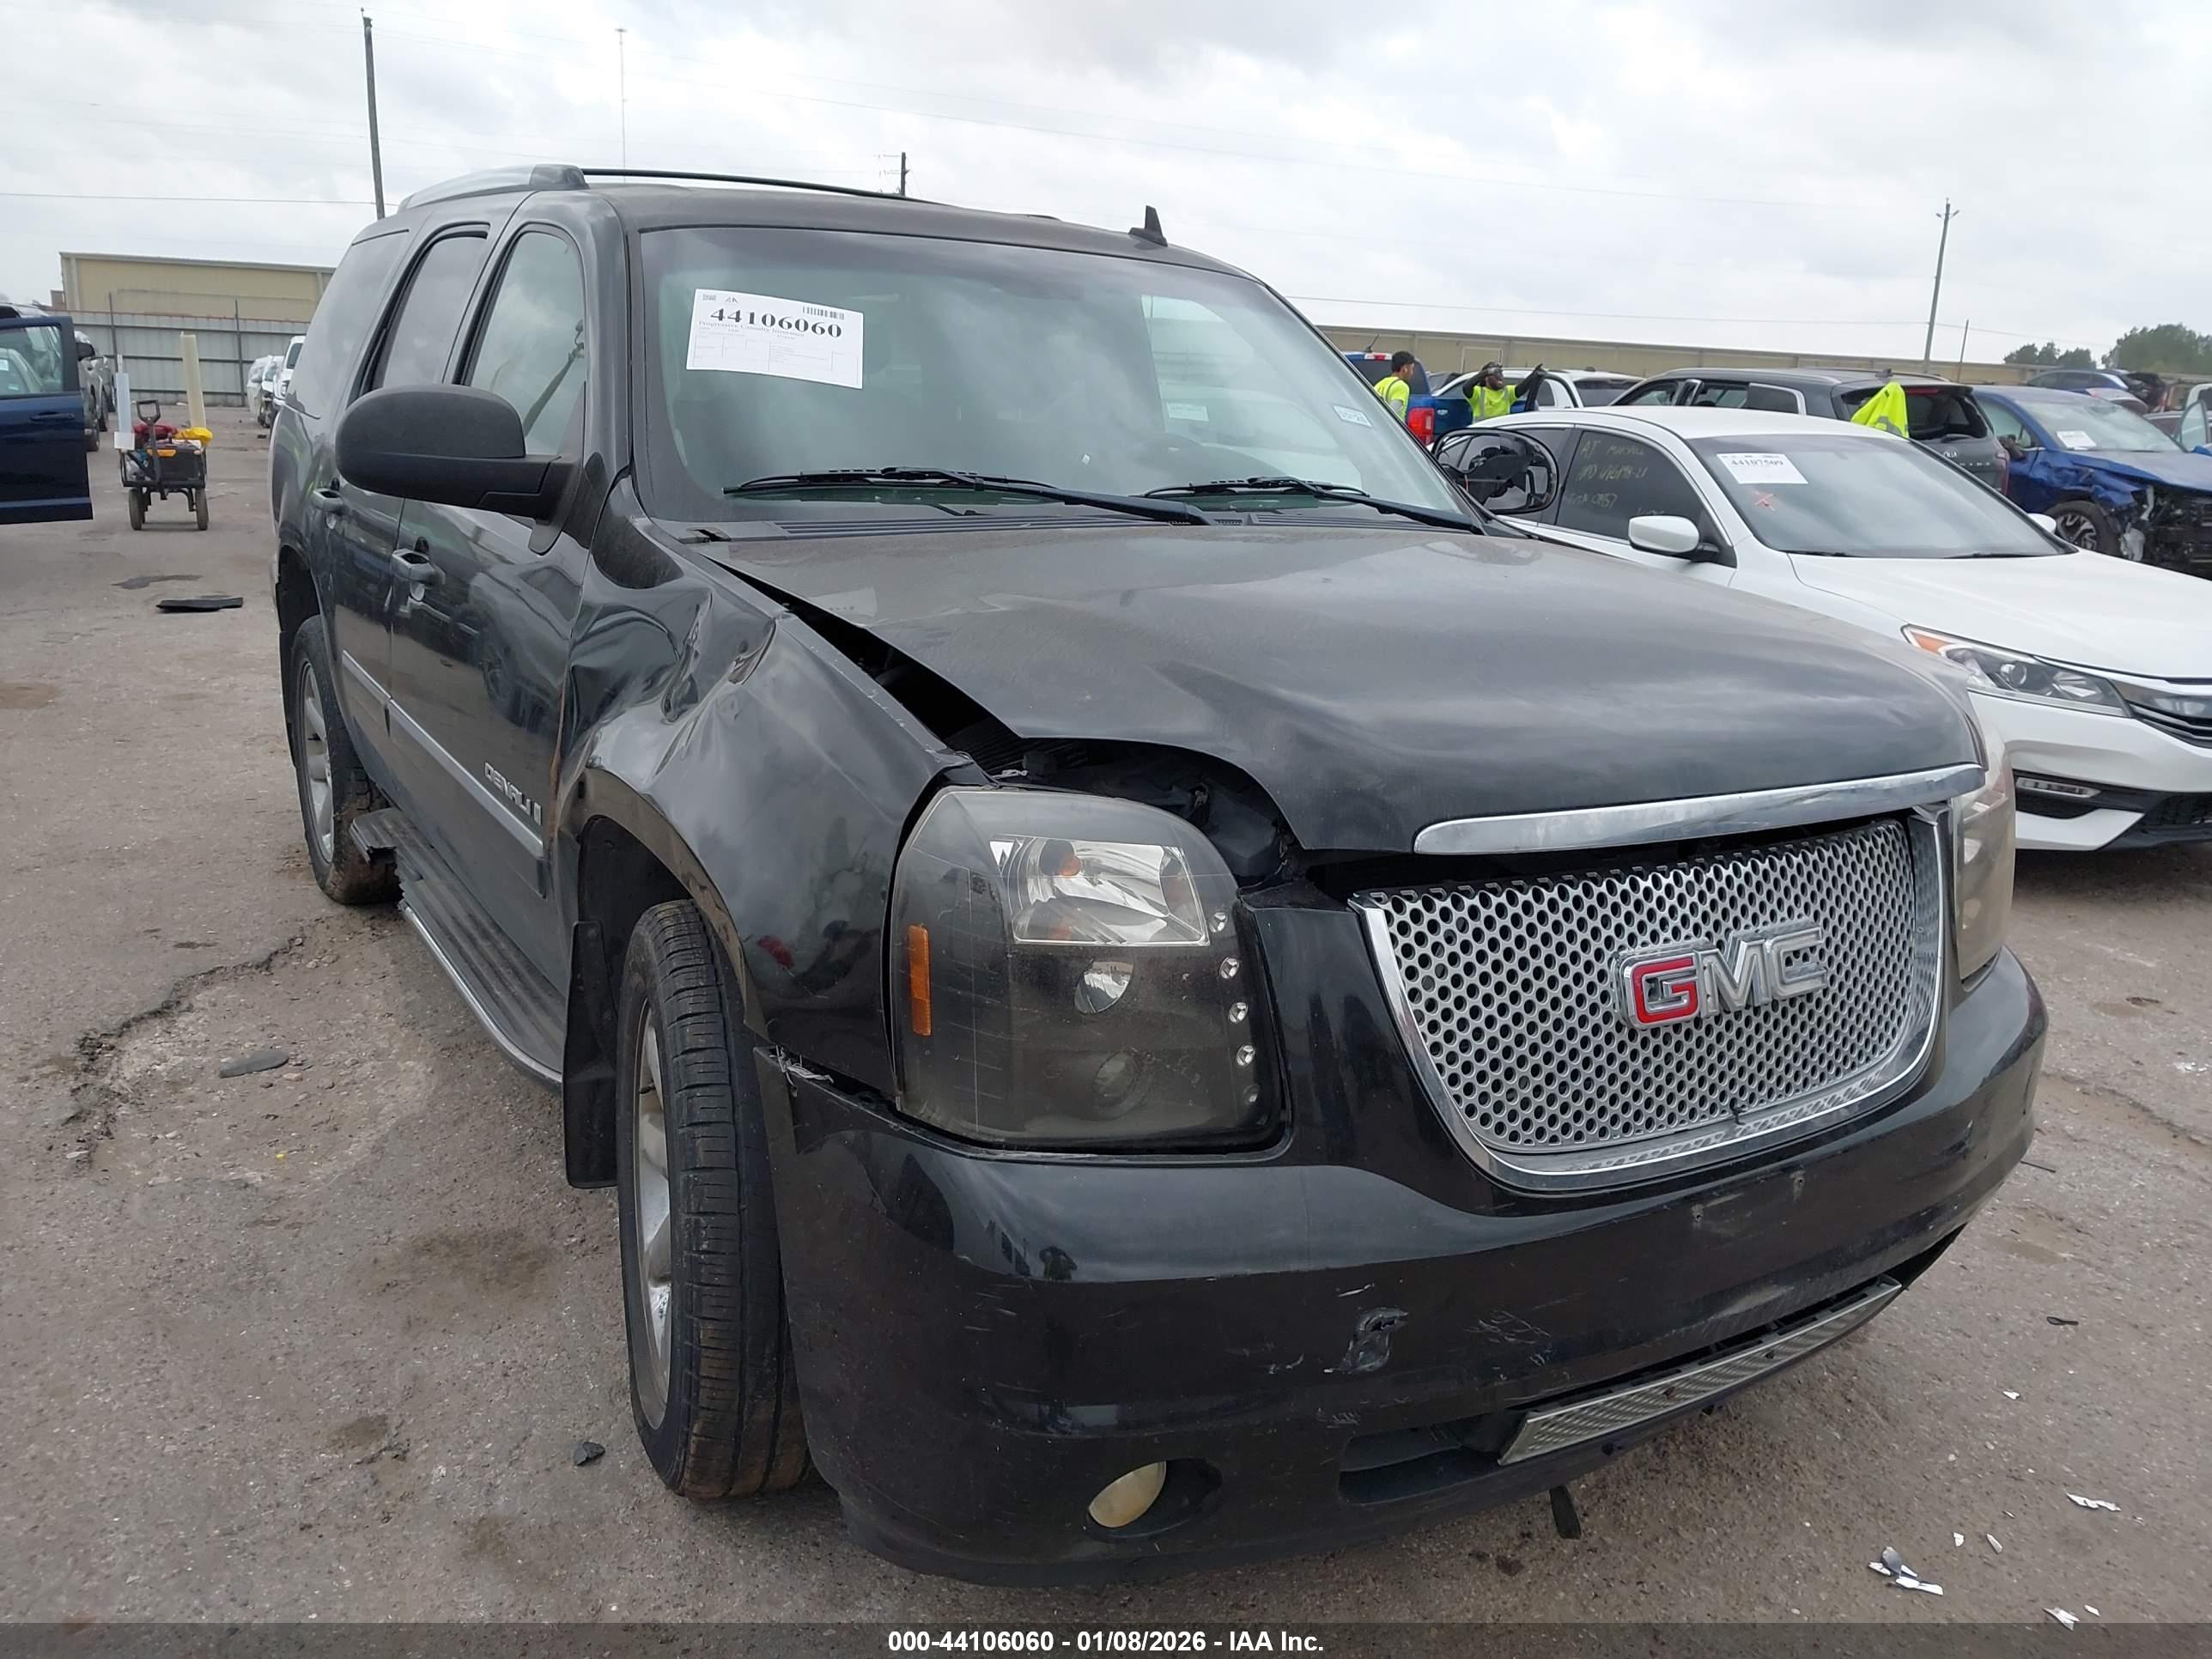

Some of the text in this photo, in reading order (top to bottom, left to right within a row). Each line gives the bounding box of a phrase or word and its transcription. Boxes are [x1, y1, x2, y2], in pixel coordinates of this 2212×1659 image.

[710, 307, 842, 338] 44106060
[484, 762, 542, 825] DENALI
[1611, 920, 1828, 1030] GMC
